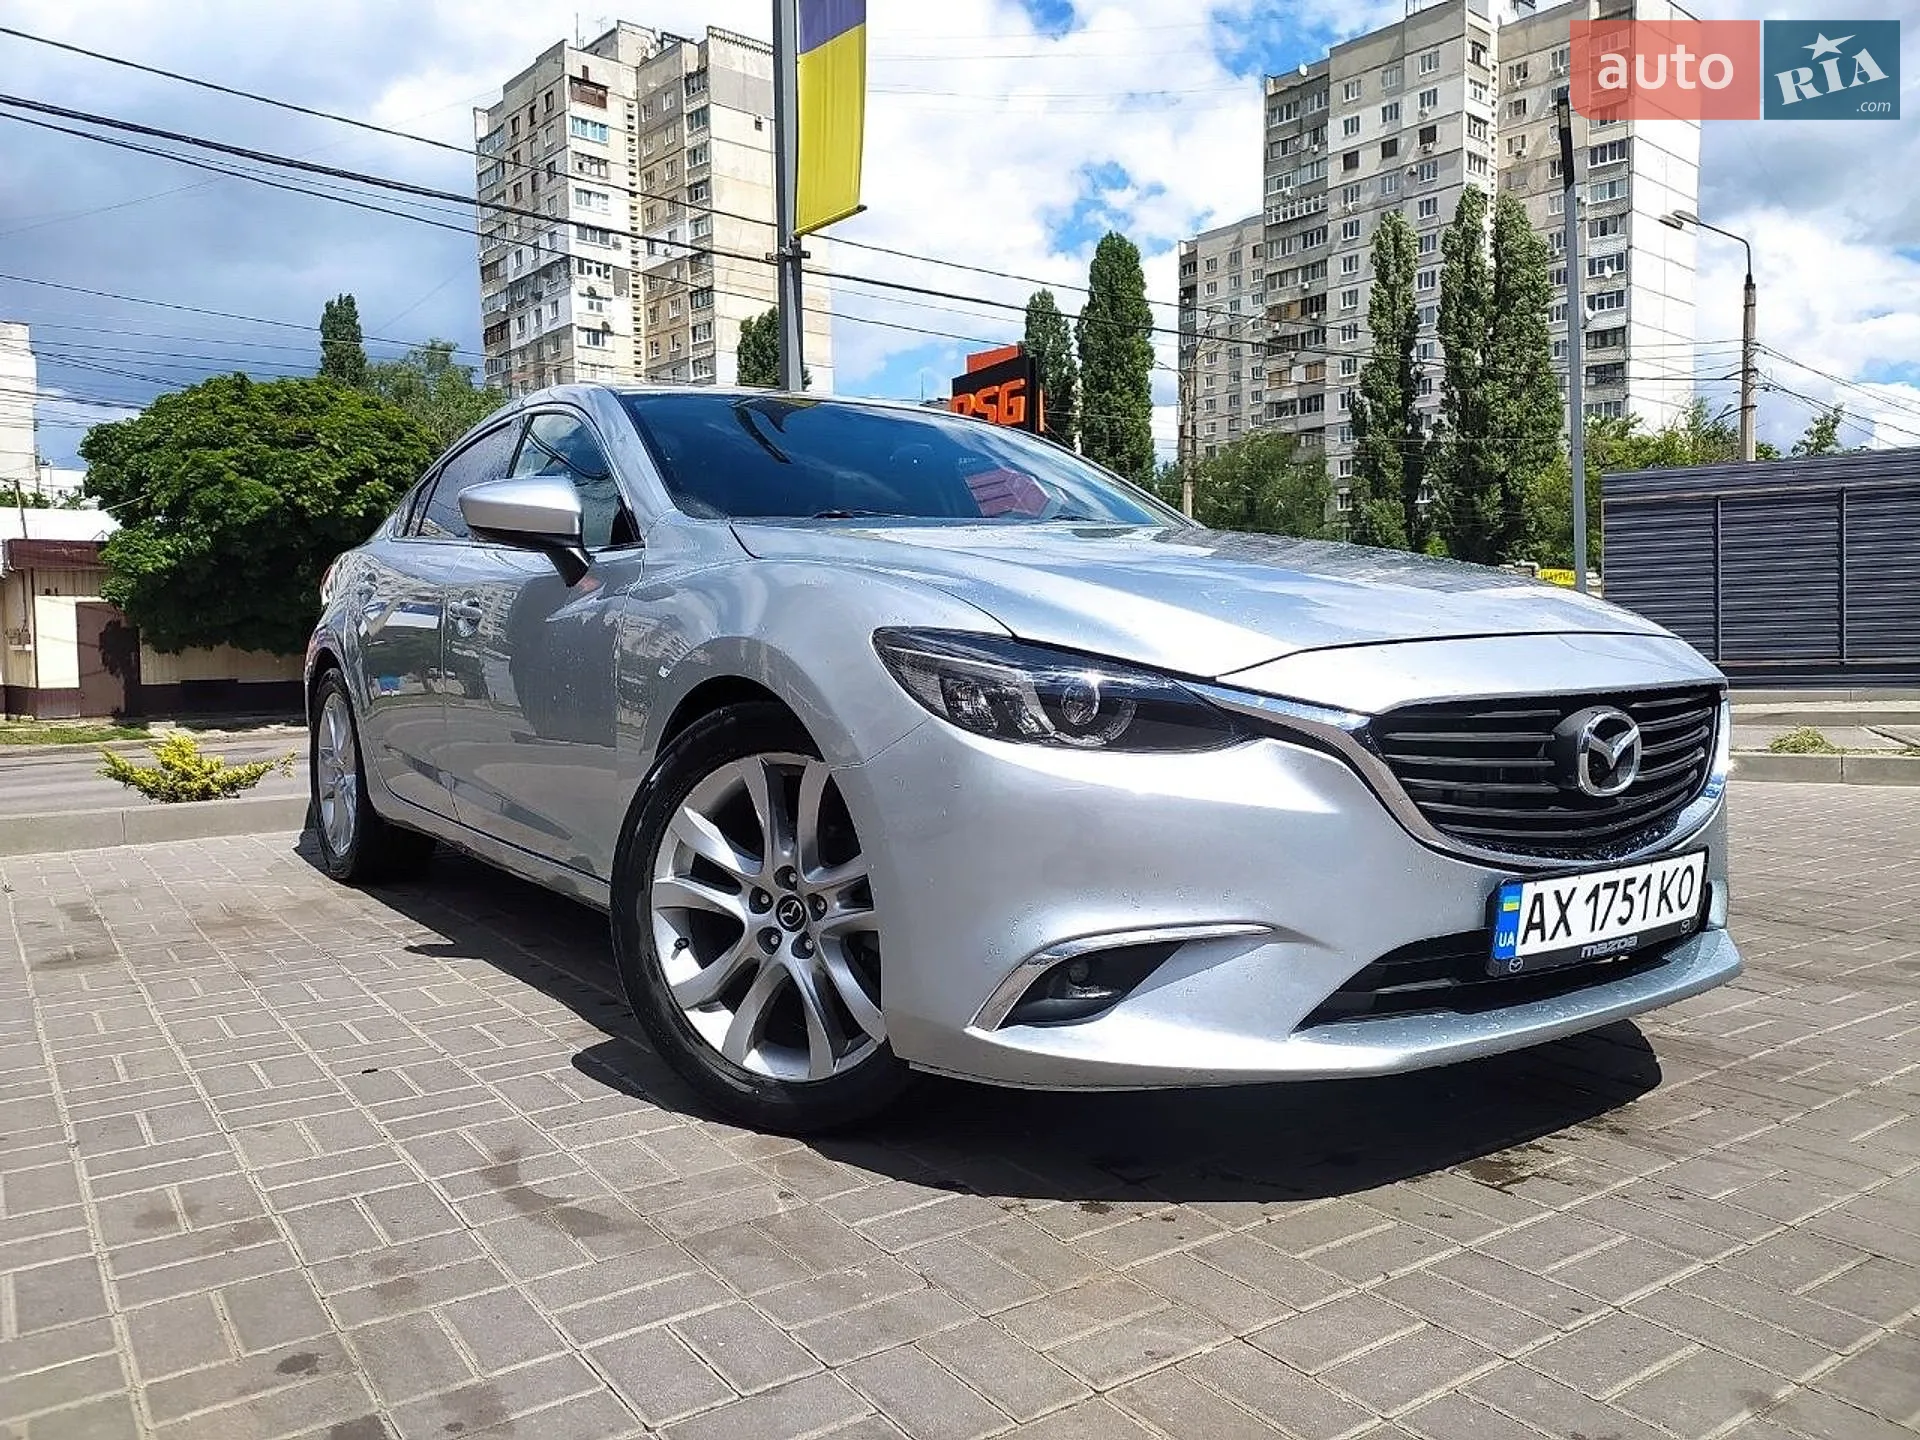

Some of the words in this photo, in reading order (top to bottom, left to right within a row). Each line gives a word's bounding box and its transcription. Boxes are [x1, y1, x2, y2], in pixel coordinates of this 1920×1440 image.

[1521, 887, 1577, 945] AX
[1585, 873, 1651, 935] 1751
[1656, 864, 1695, 918] KO
[1499, 930, 1515, 948] UA
